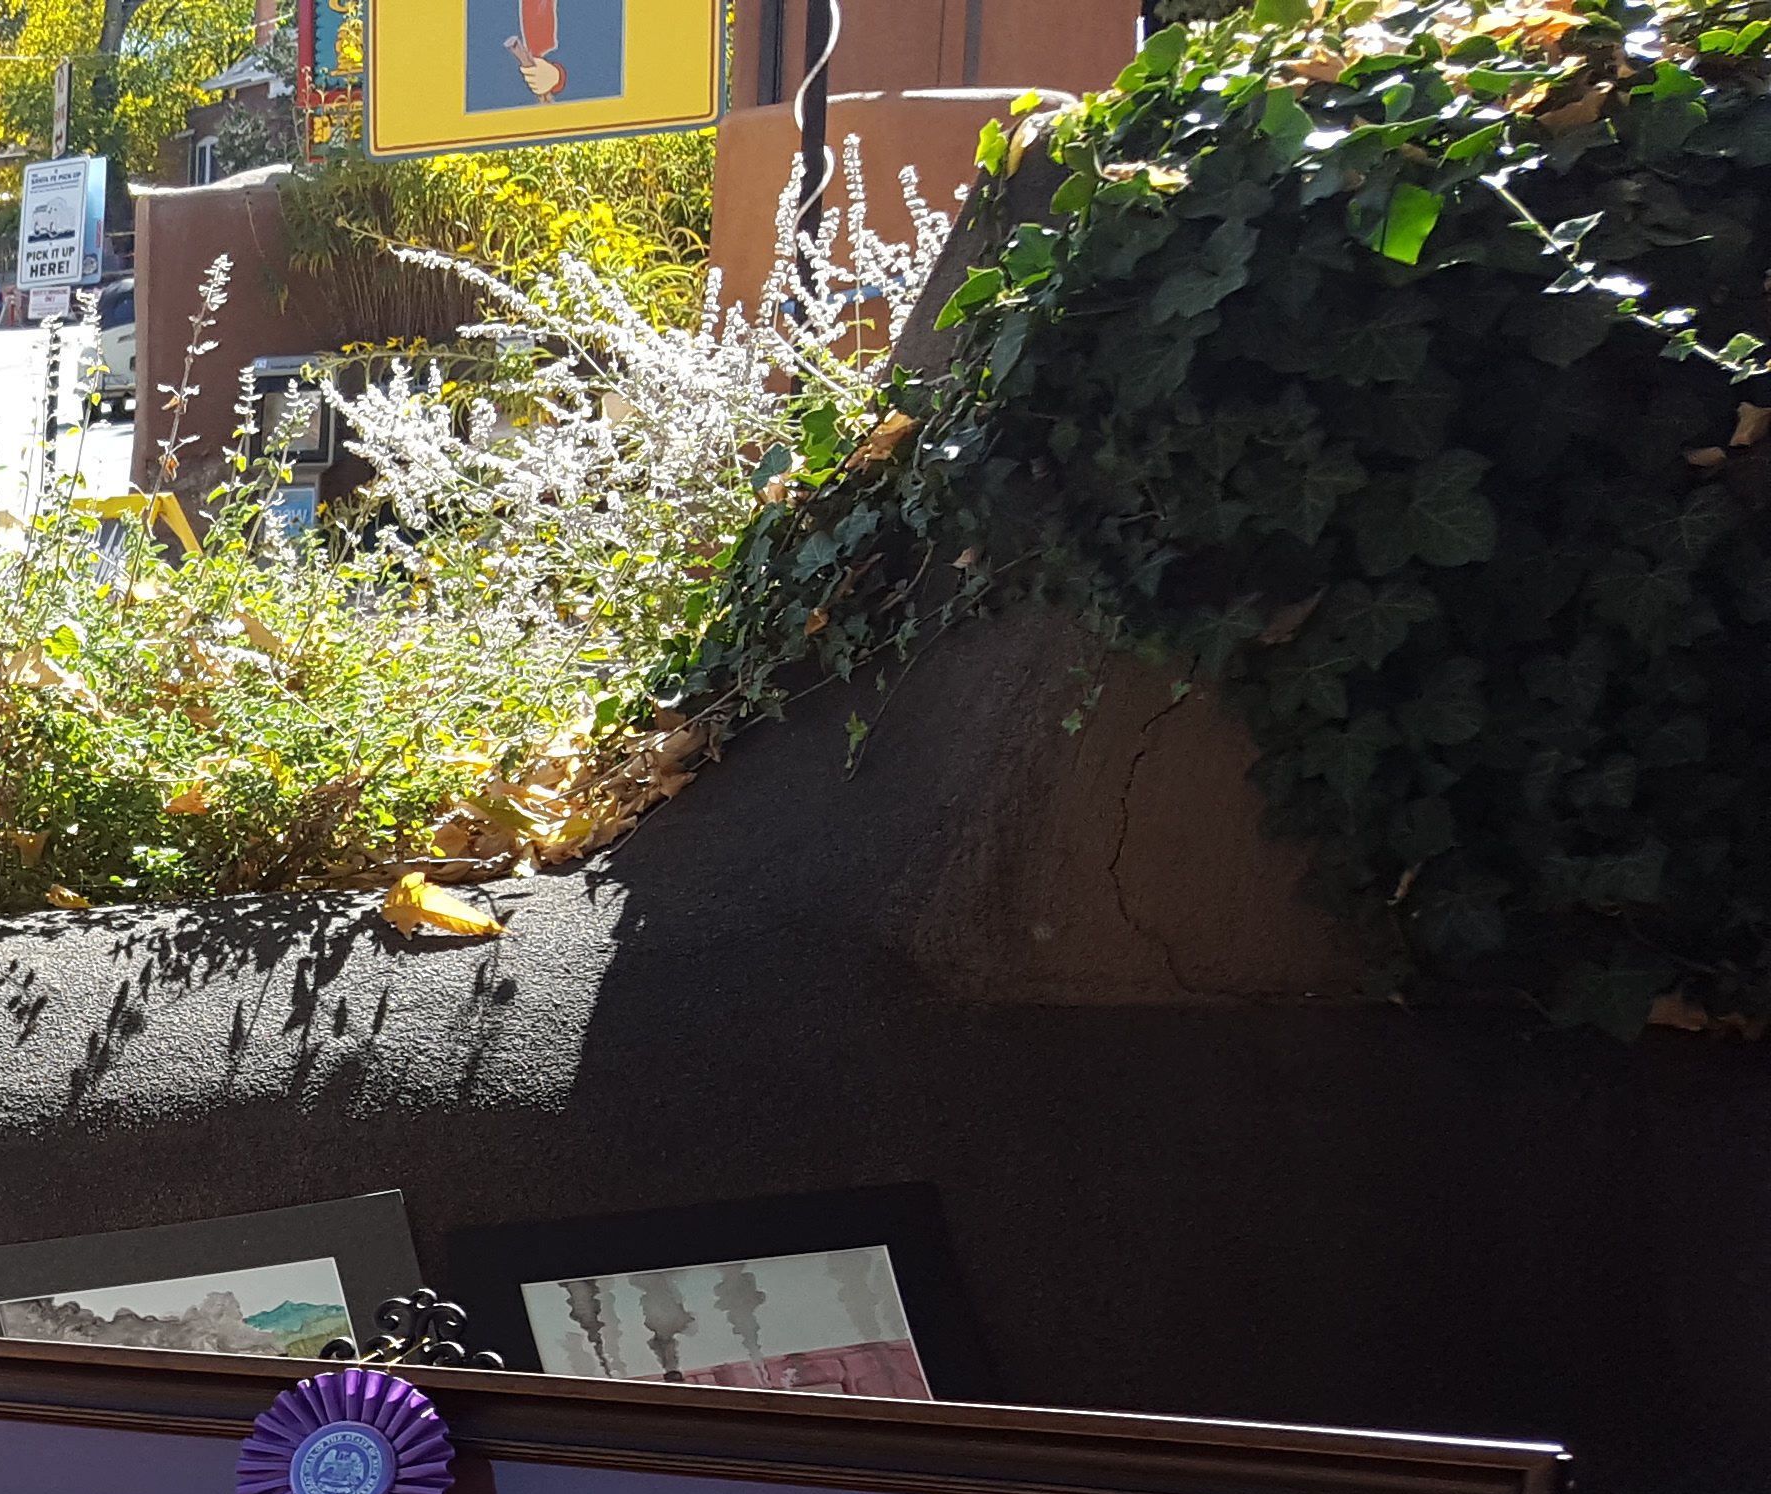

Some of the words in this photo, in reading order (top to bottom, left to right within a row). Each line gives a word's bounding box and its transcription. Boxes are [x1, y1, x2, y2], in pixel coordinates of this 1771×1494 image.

[26, 249, 49, 263] PICK
[51, 247, 60, 259] IT
[62, 246, 75, 258] UP
[29, 259, 70, 278] HERE!
